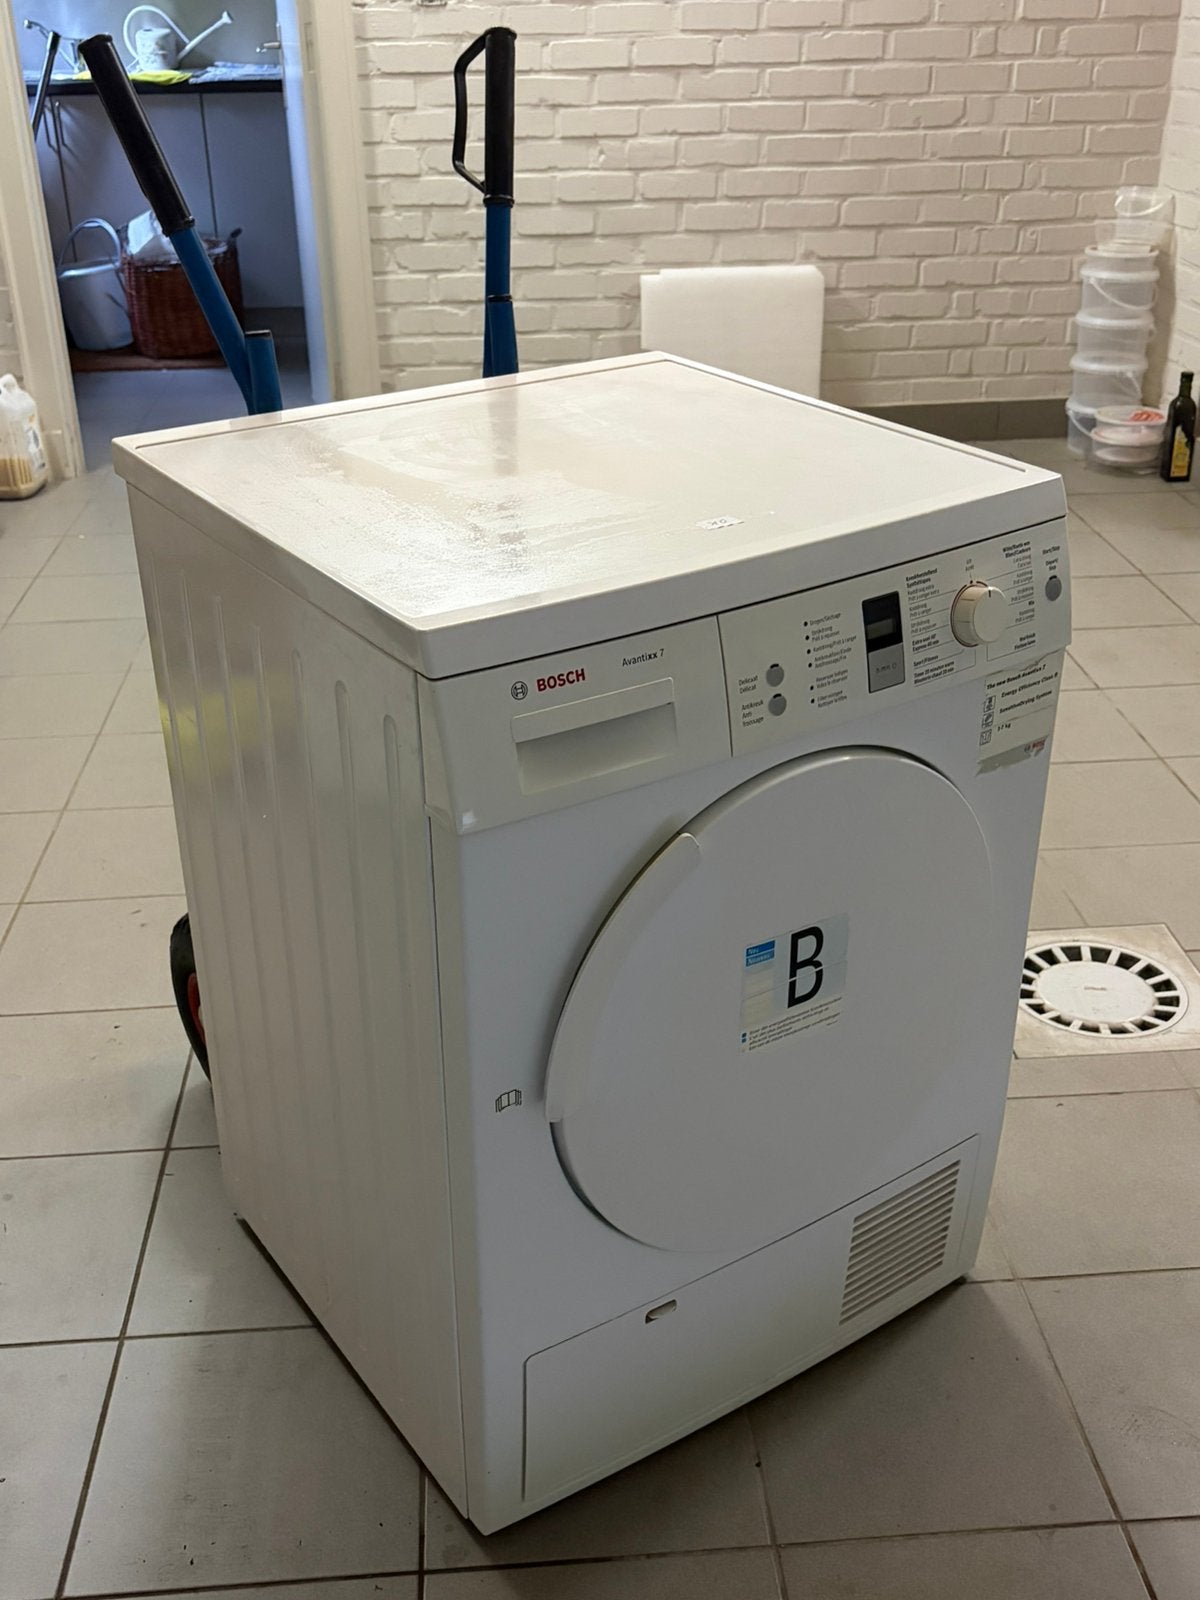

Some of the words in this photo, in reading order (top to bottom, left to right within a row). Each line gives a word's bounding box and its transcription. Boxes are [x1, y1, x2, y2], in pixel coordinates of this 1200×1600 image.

[622, 650, 658, 667] Avantixx
[660, 648, 665, 657] 7
[536, 668, 586, 692] BOSCH
[787, 925, 824, 1009] B
